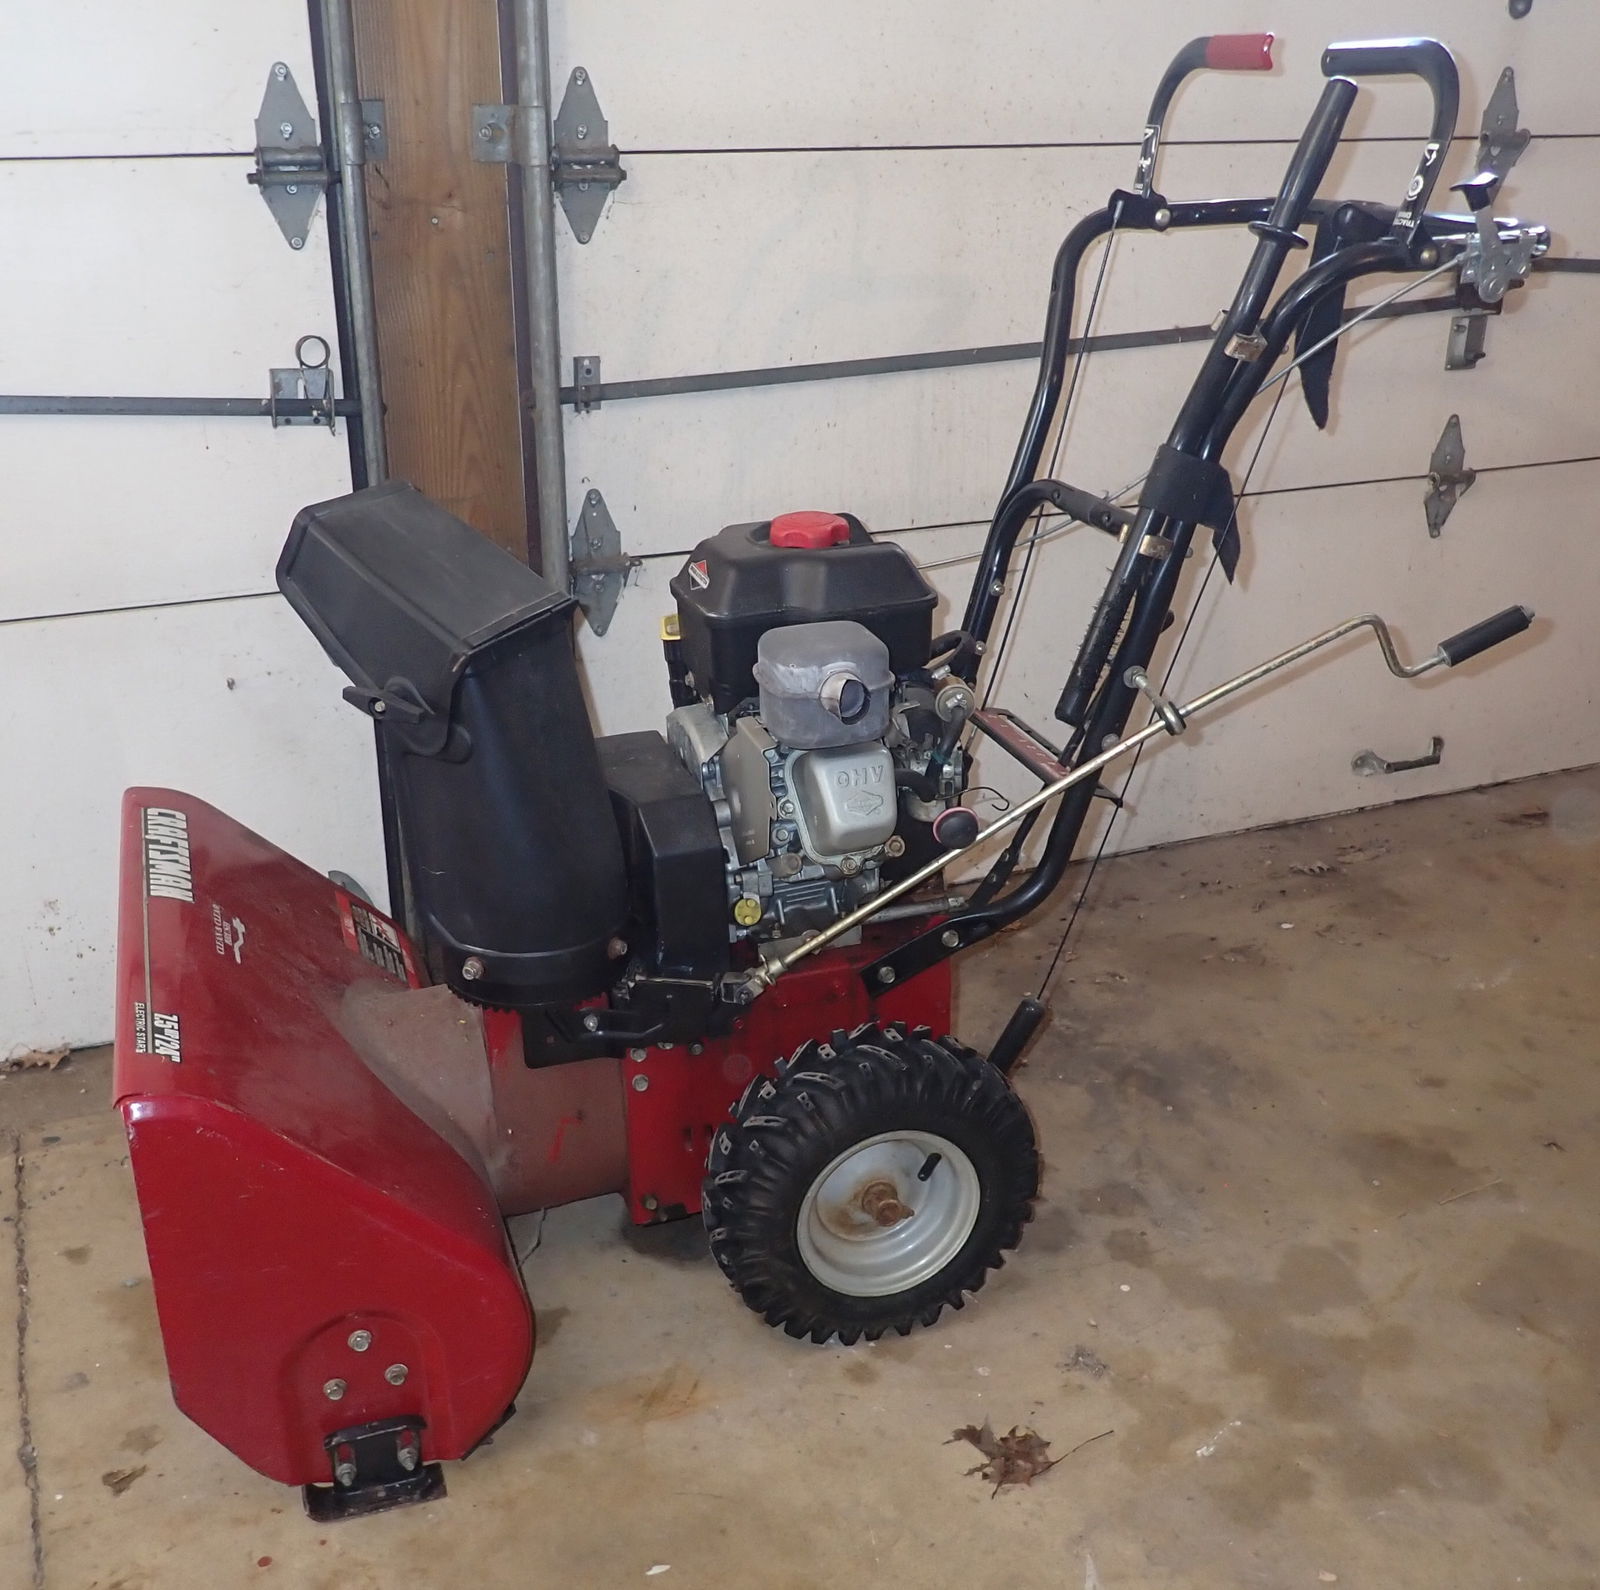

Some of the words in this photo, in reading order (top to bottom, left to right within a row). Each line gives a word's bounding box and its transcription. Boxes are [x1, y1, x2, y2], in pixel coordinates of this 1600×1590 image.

[834, 764, 884, 787] OHV
[146, 807, 194, 903] CRAFTSMAN
[135, 1001, 146, 1032] ELECTRIC
[135, 1032, 146, 1054] START
